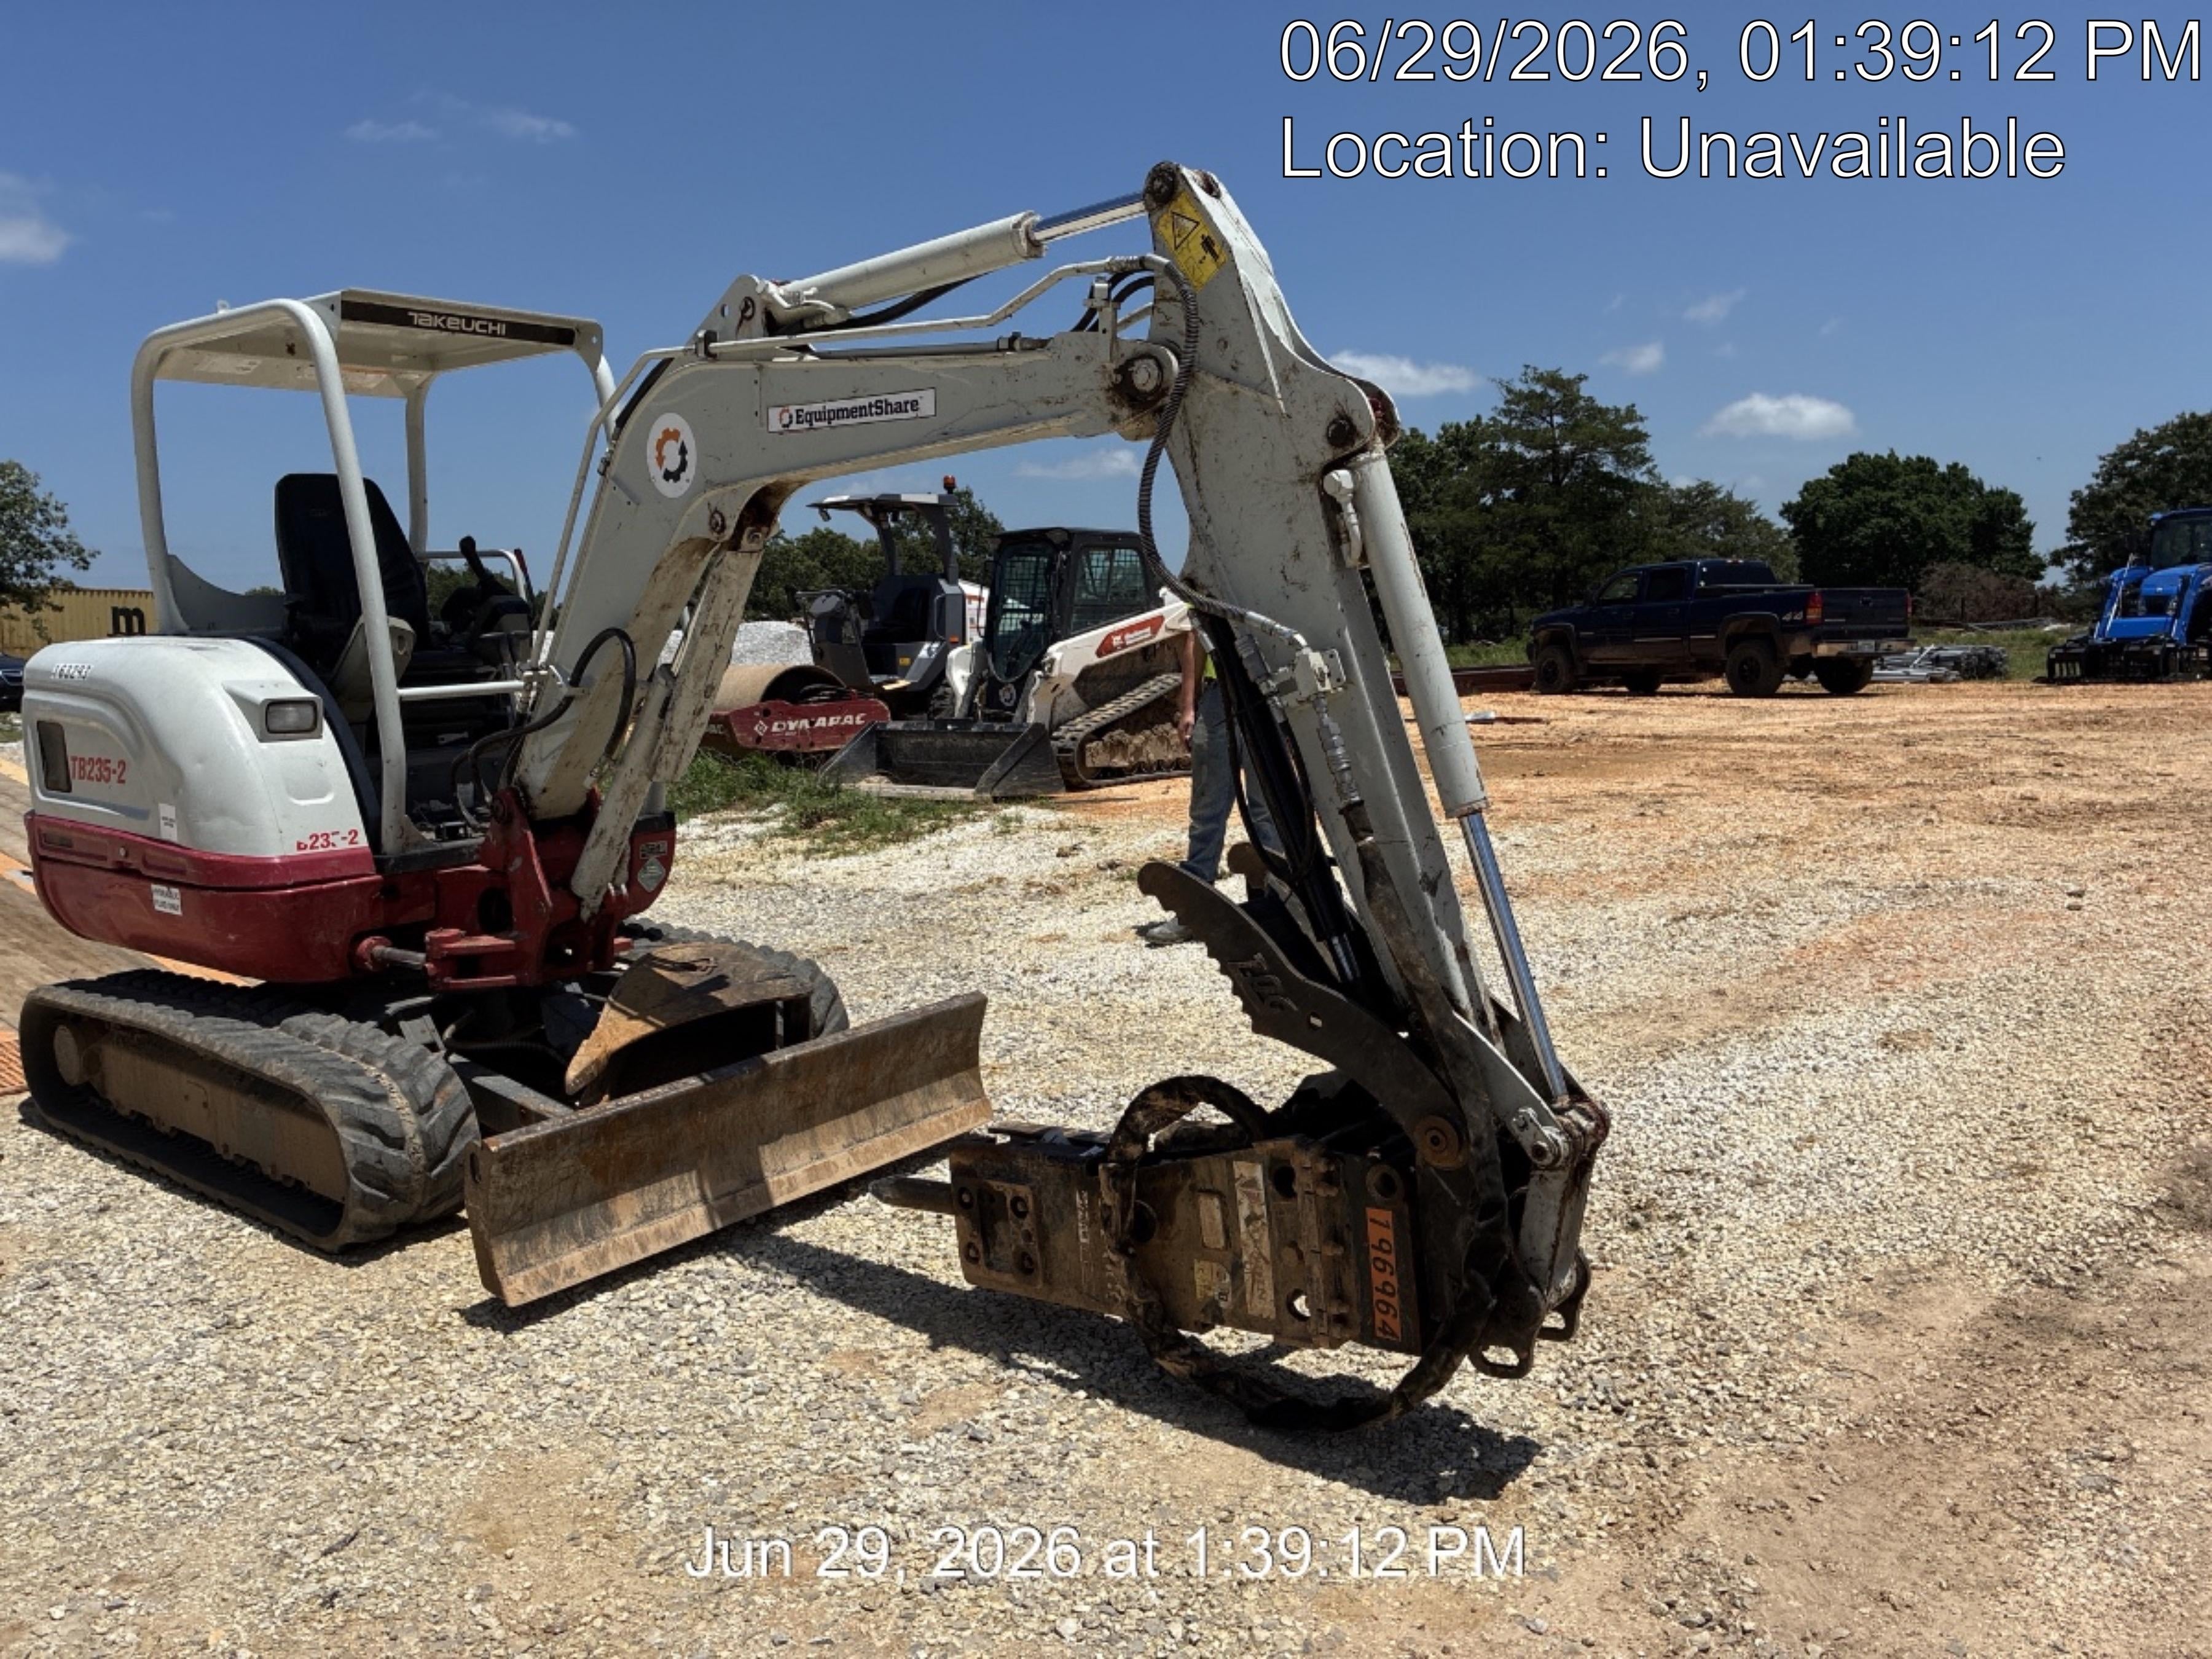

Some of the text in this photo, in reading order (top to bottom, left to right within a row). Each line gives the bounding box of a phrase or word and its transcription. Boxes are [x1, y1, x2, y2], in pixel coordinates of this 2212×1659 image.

[795, 398, 919, 426] EquipmentShare
[771, 713, 867, 733] DYNAPAC
[70, 756, 126, 784] TB235-2
[1369, 1217, 1400, 1340] 196964
